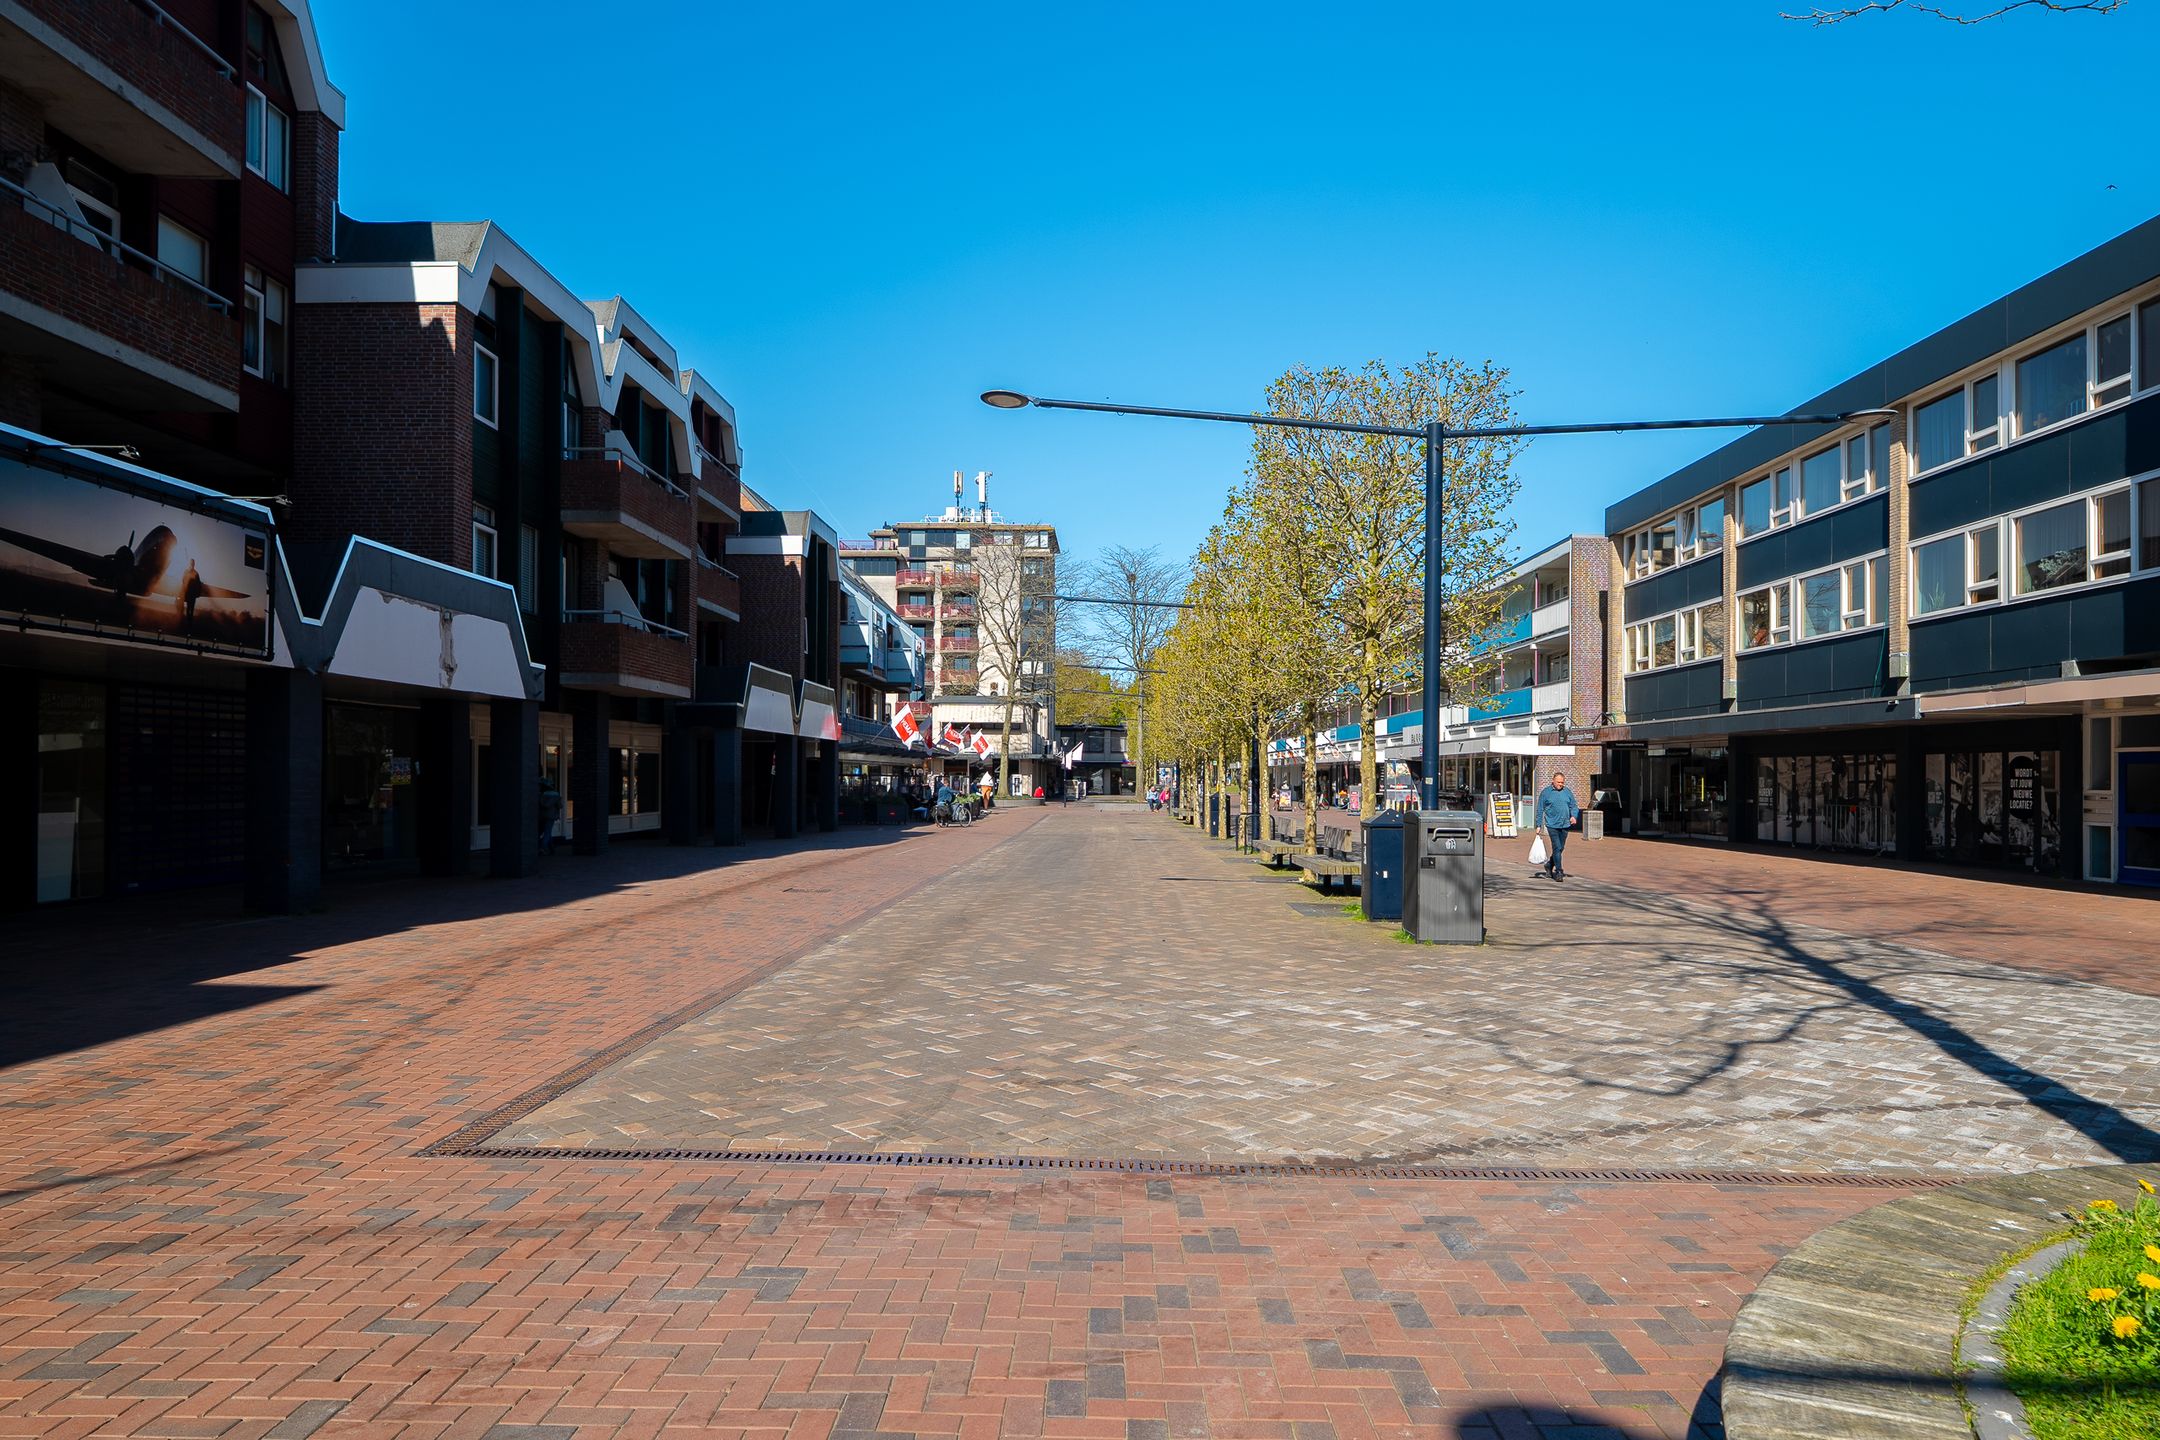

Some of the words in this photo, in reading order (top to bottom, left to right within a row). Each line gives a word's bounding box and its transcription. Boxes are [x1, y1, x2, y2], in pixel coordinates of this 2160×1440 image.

[900, 718, 914, 736] HEMA
[2014, 768, 2033, 778] WORDT
[2010, 778, 2019, 788] DIT
[2019, 779, 2033, 788] JOUW
[2012, 789, 2033, 799] NIEUWE
[2009, 800, 2033, 810] LOCATIE?
